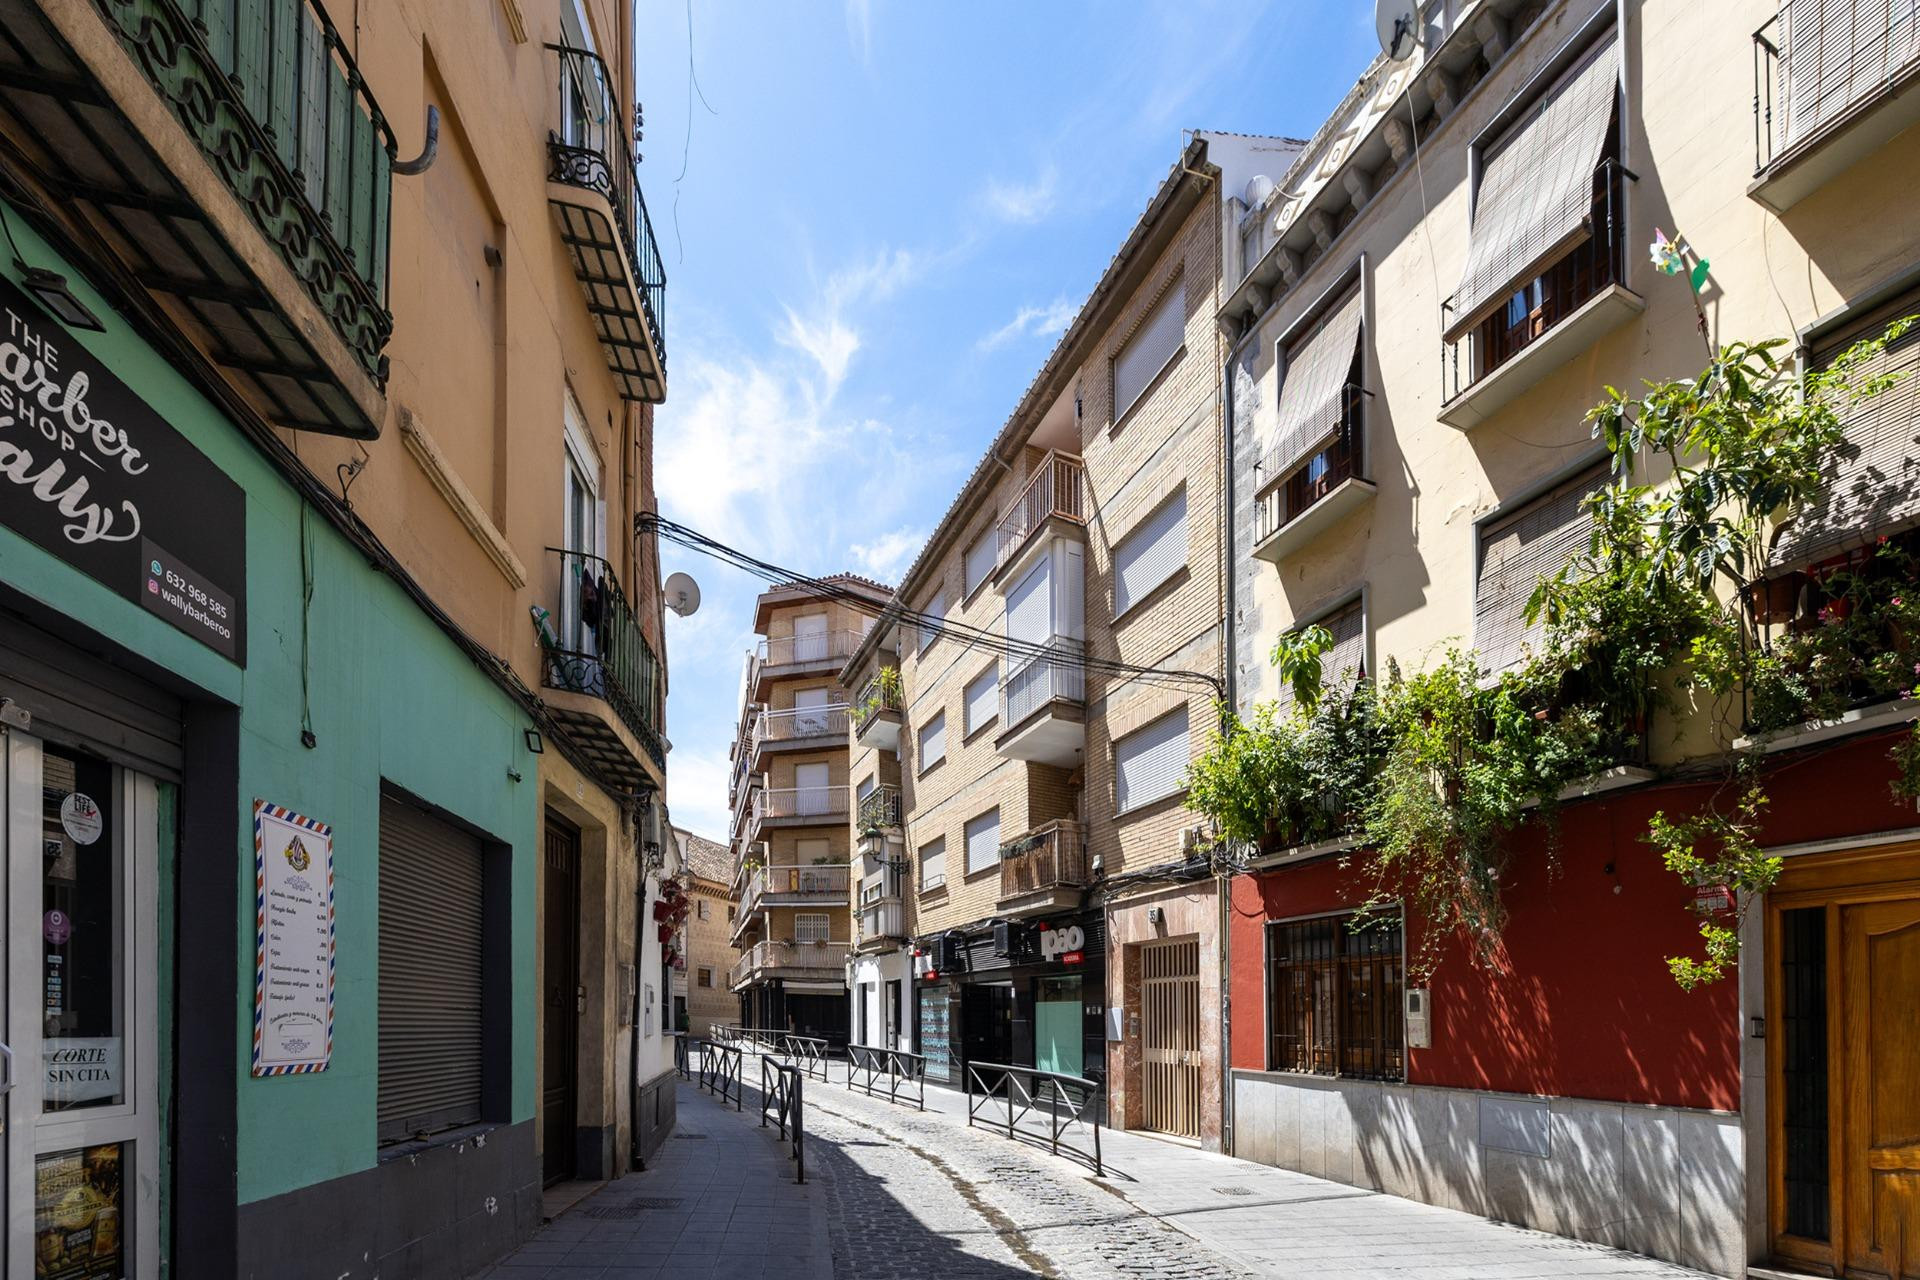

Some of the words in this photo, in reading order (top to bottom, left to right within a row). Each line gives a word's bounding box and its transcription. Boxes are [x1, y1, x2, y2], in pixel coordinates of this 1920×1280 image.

[6, 307, 58, 373] THE
[0, 342, 149, 475] arber
[0, 384, 75, 451] SHOP
[0, 416, 140, 544] ally
[161, 588, 230, 639] wallybarberoo
[166, 570, 186, 593] 632
[188, 584, 207, 606] 968
[209, 598, 227, 619] 585
[48, 1069, 75, 1083] SIN
[77, 1068, 111, 1081] CITA
[52, 1048, 107, 1063] CORTE
